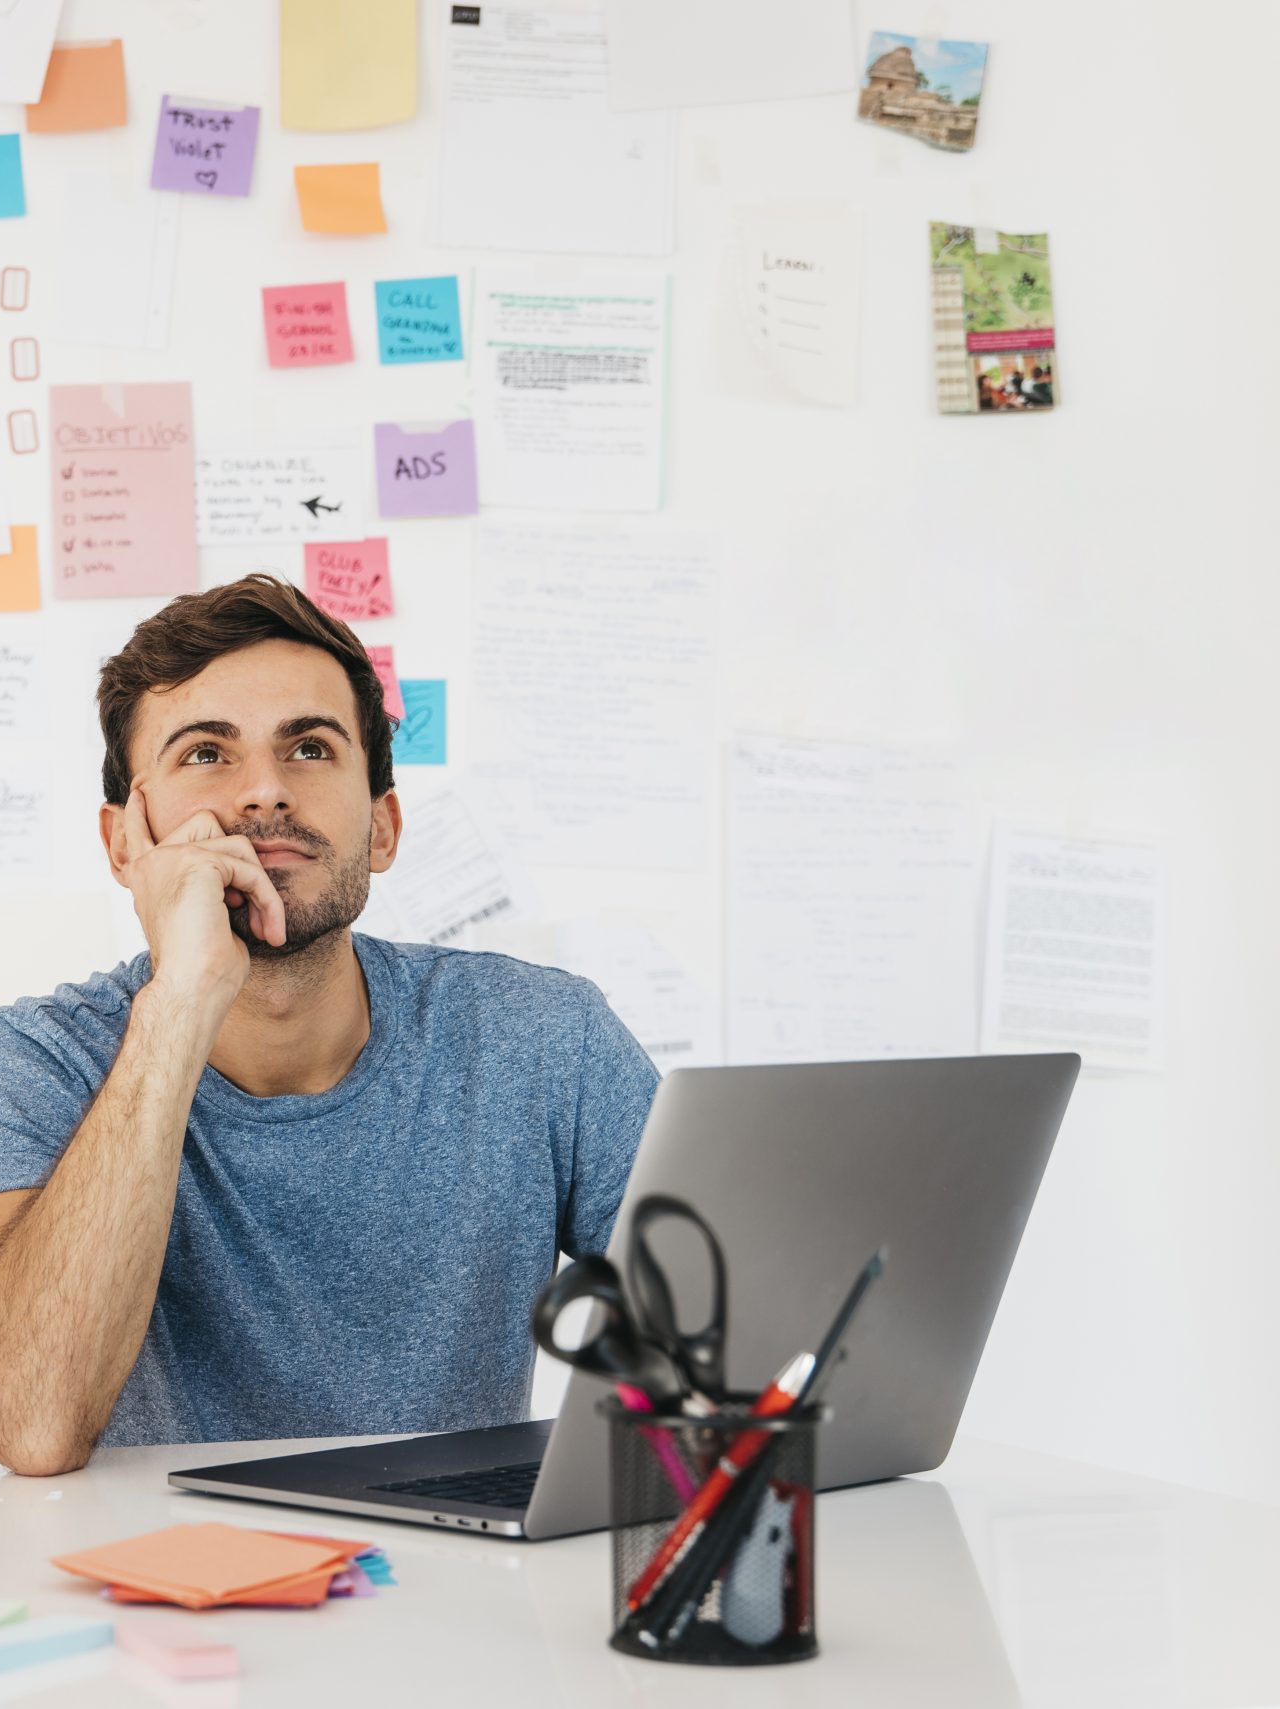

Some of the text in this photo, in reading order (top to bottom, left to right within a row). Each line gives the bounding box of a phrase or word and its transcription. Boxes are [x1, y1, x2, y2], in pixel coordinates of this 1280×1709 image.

[387, 290, 440, 311] CALL
[394, 453, 448, 483] ADS
[317, 549, 363, 573] CLUB
